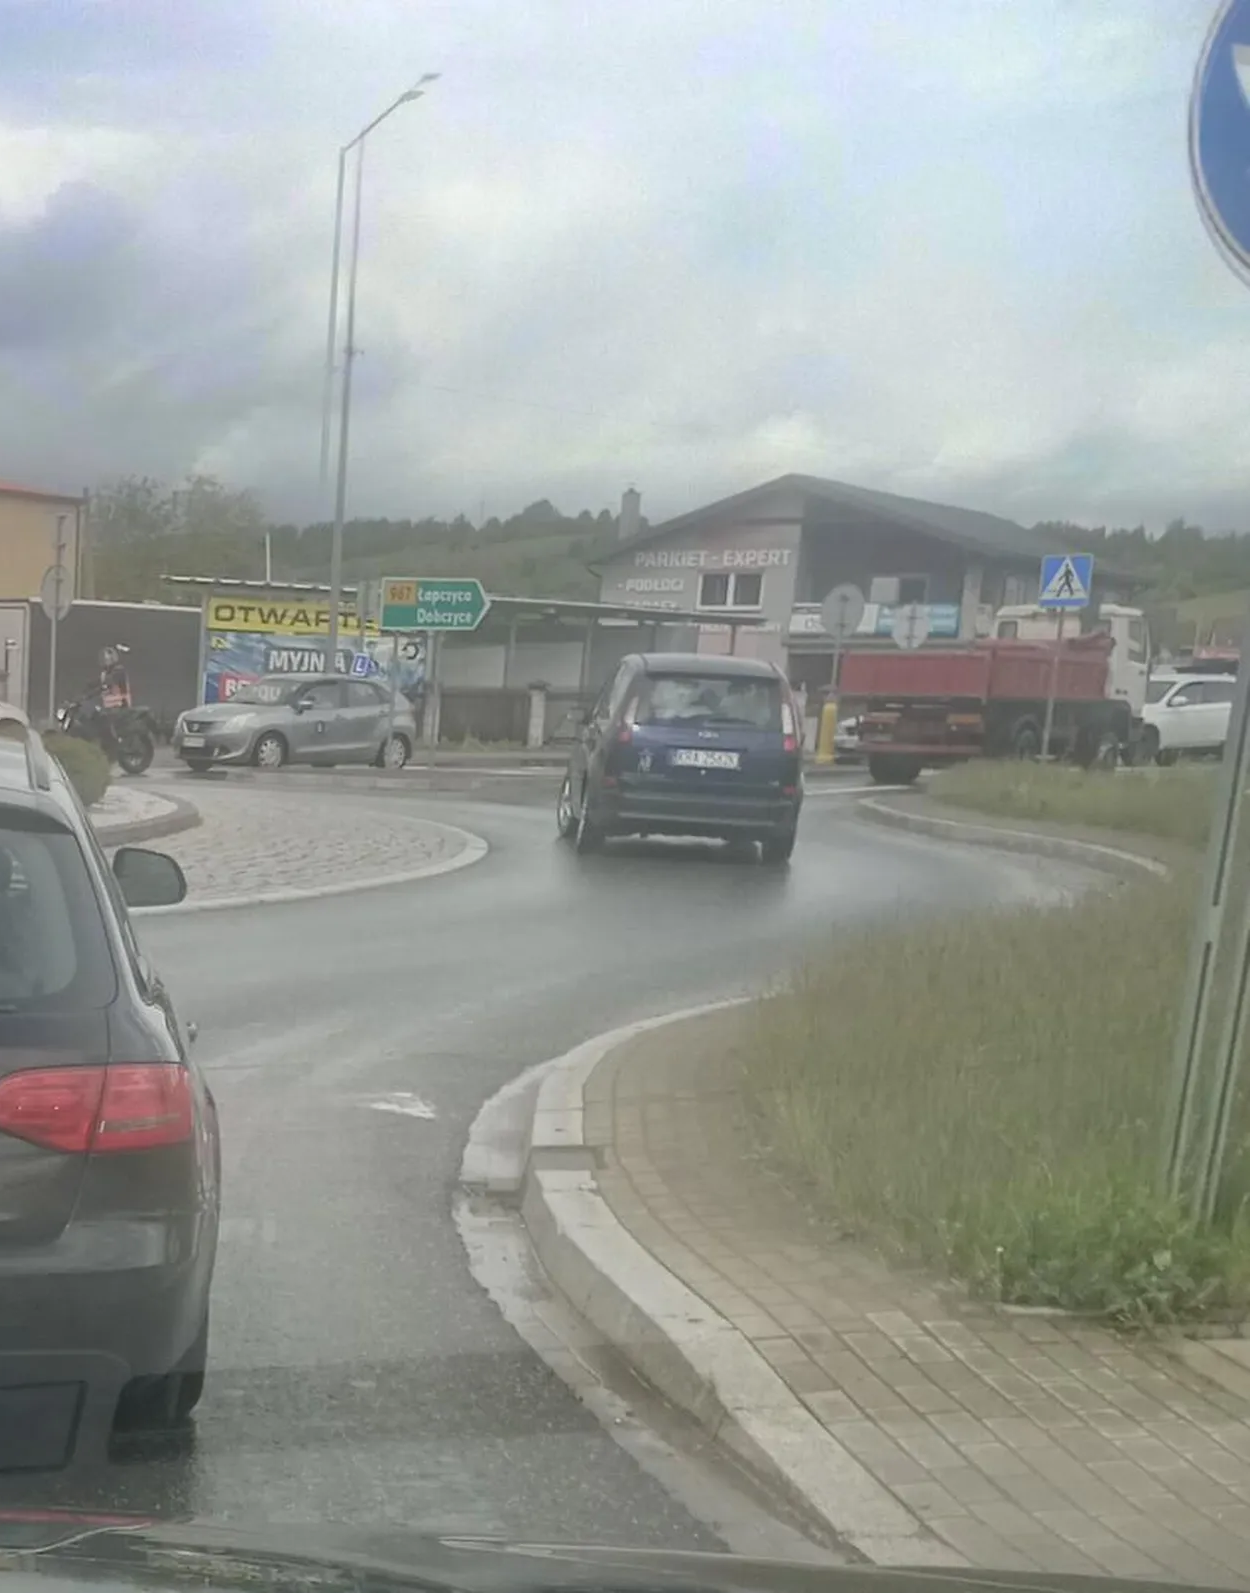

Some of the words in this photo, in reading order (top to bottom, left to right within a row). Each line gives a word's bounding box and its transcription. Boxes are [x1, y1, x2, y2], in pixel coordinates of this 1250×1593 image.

[635, 551, 708, 567] PARKIET
[723, 550, 792, 567] EXPERT
[269, 650, 347, 673] MYJNA
